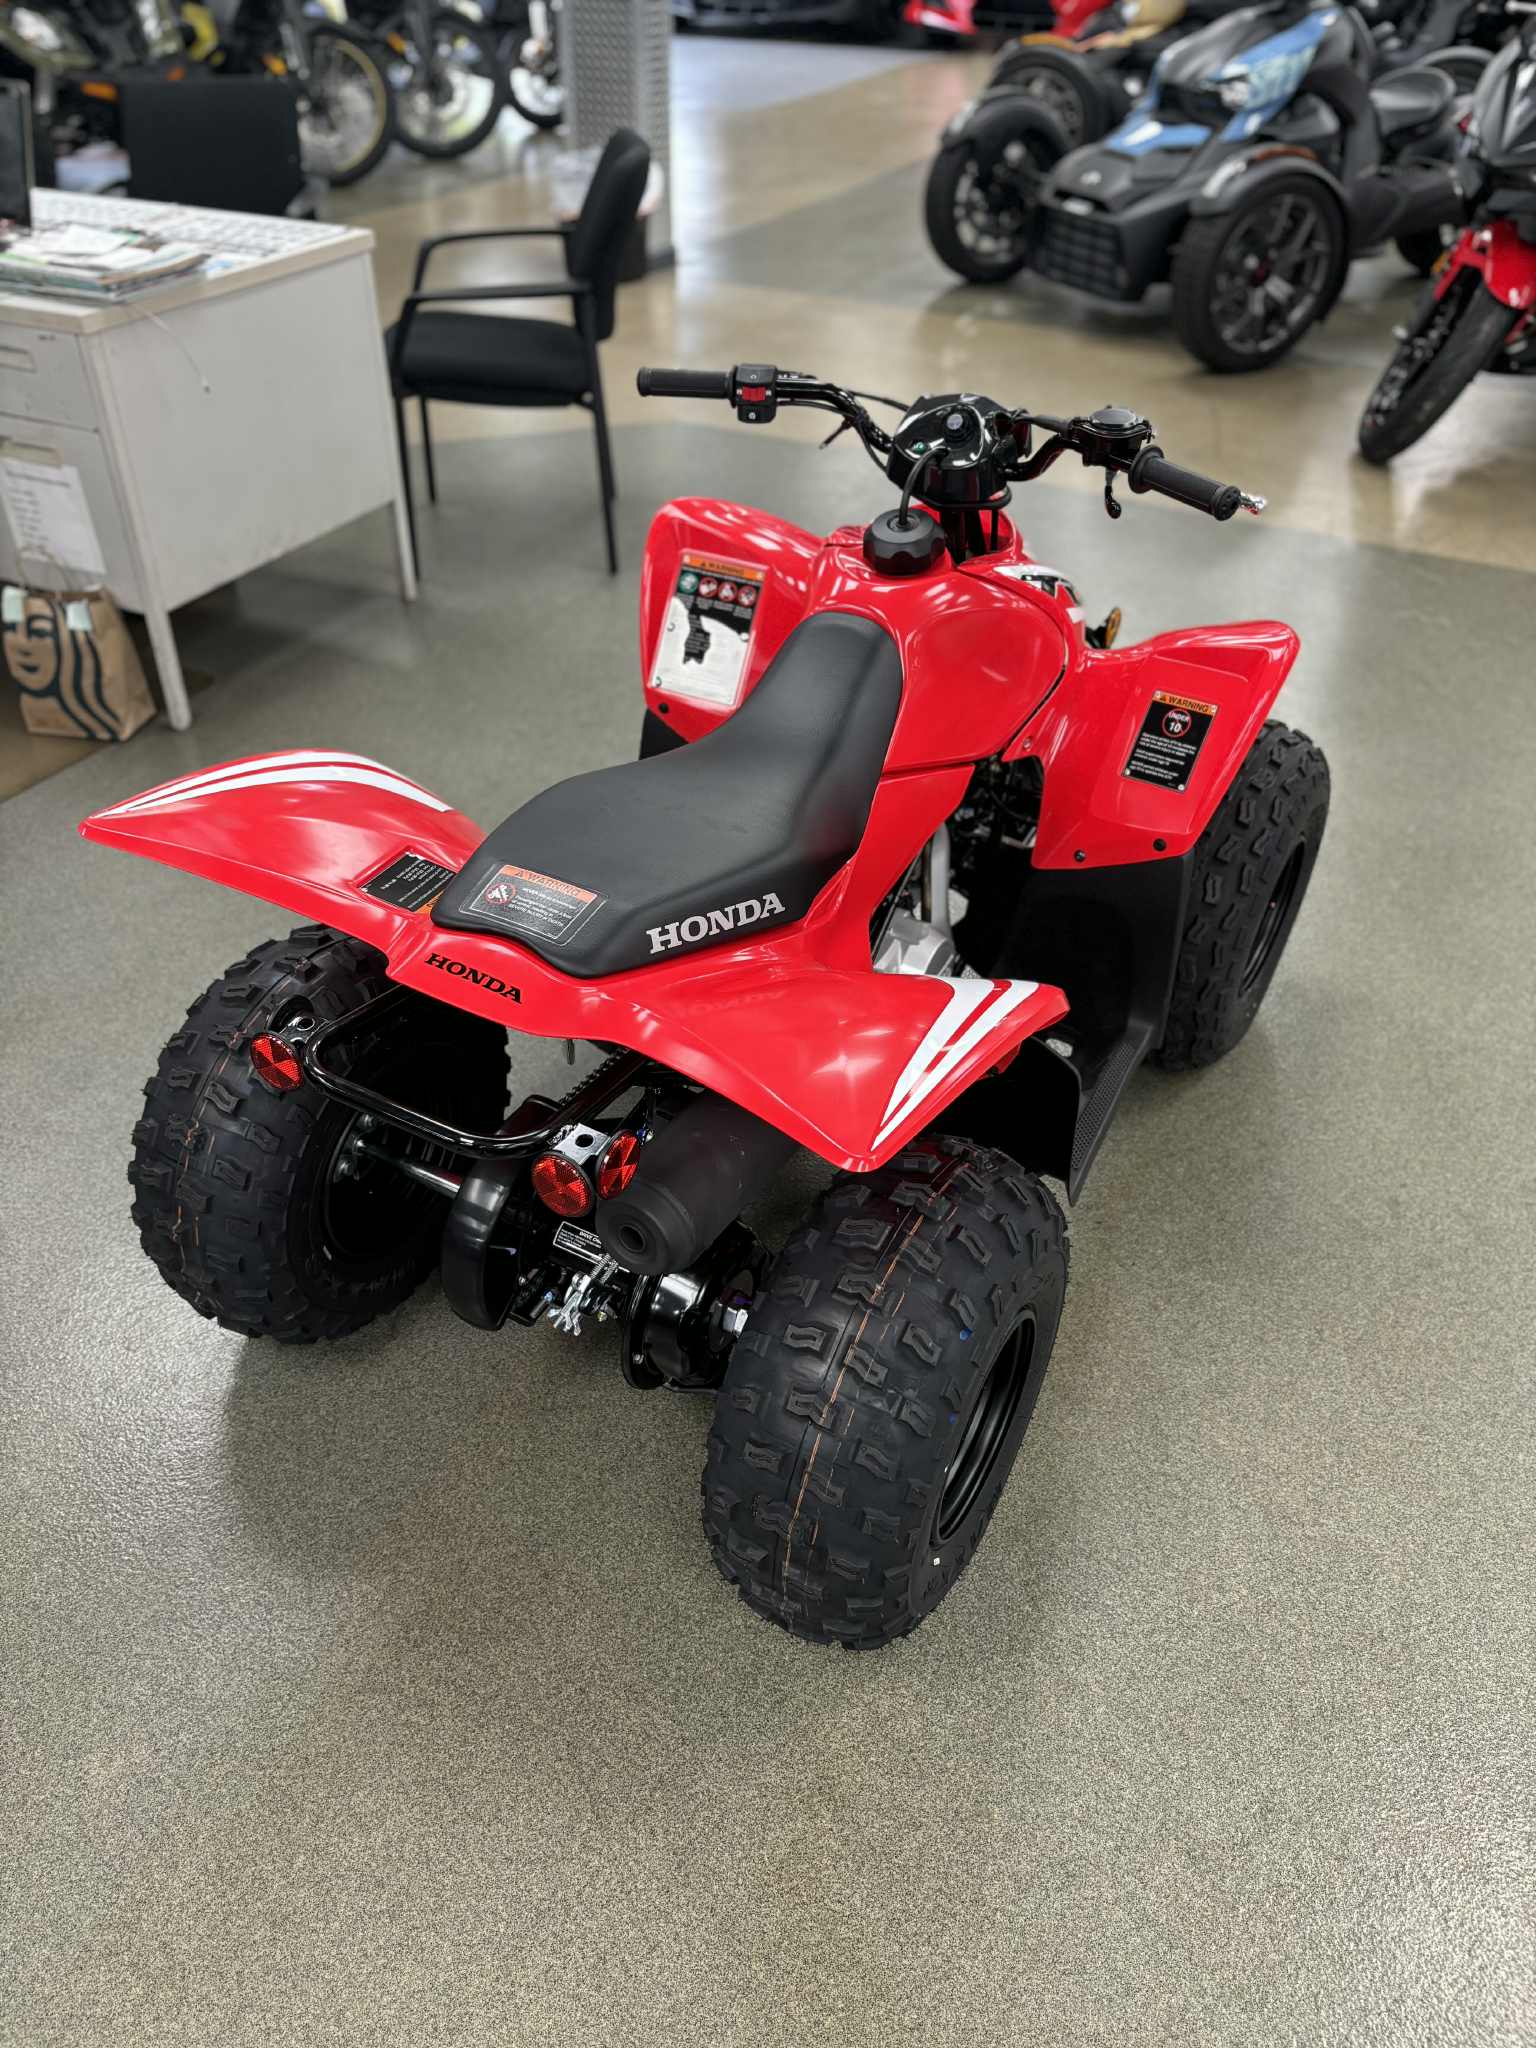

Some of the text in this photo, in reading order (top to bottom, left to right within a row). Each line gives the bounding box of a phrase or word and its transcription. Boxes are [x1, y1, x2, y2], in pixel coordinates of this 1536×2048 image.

[1168, 696, 1209, 713] WARNING
[1169, 722, 1182, 733] 10
[646, 892, 785, 954] HONDA
[424, 952, 522, 1004] HONDA
